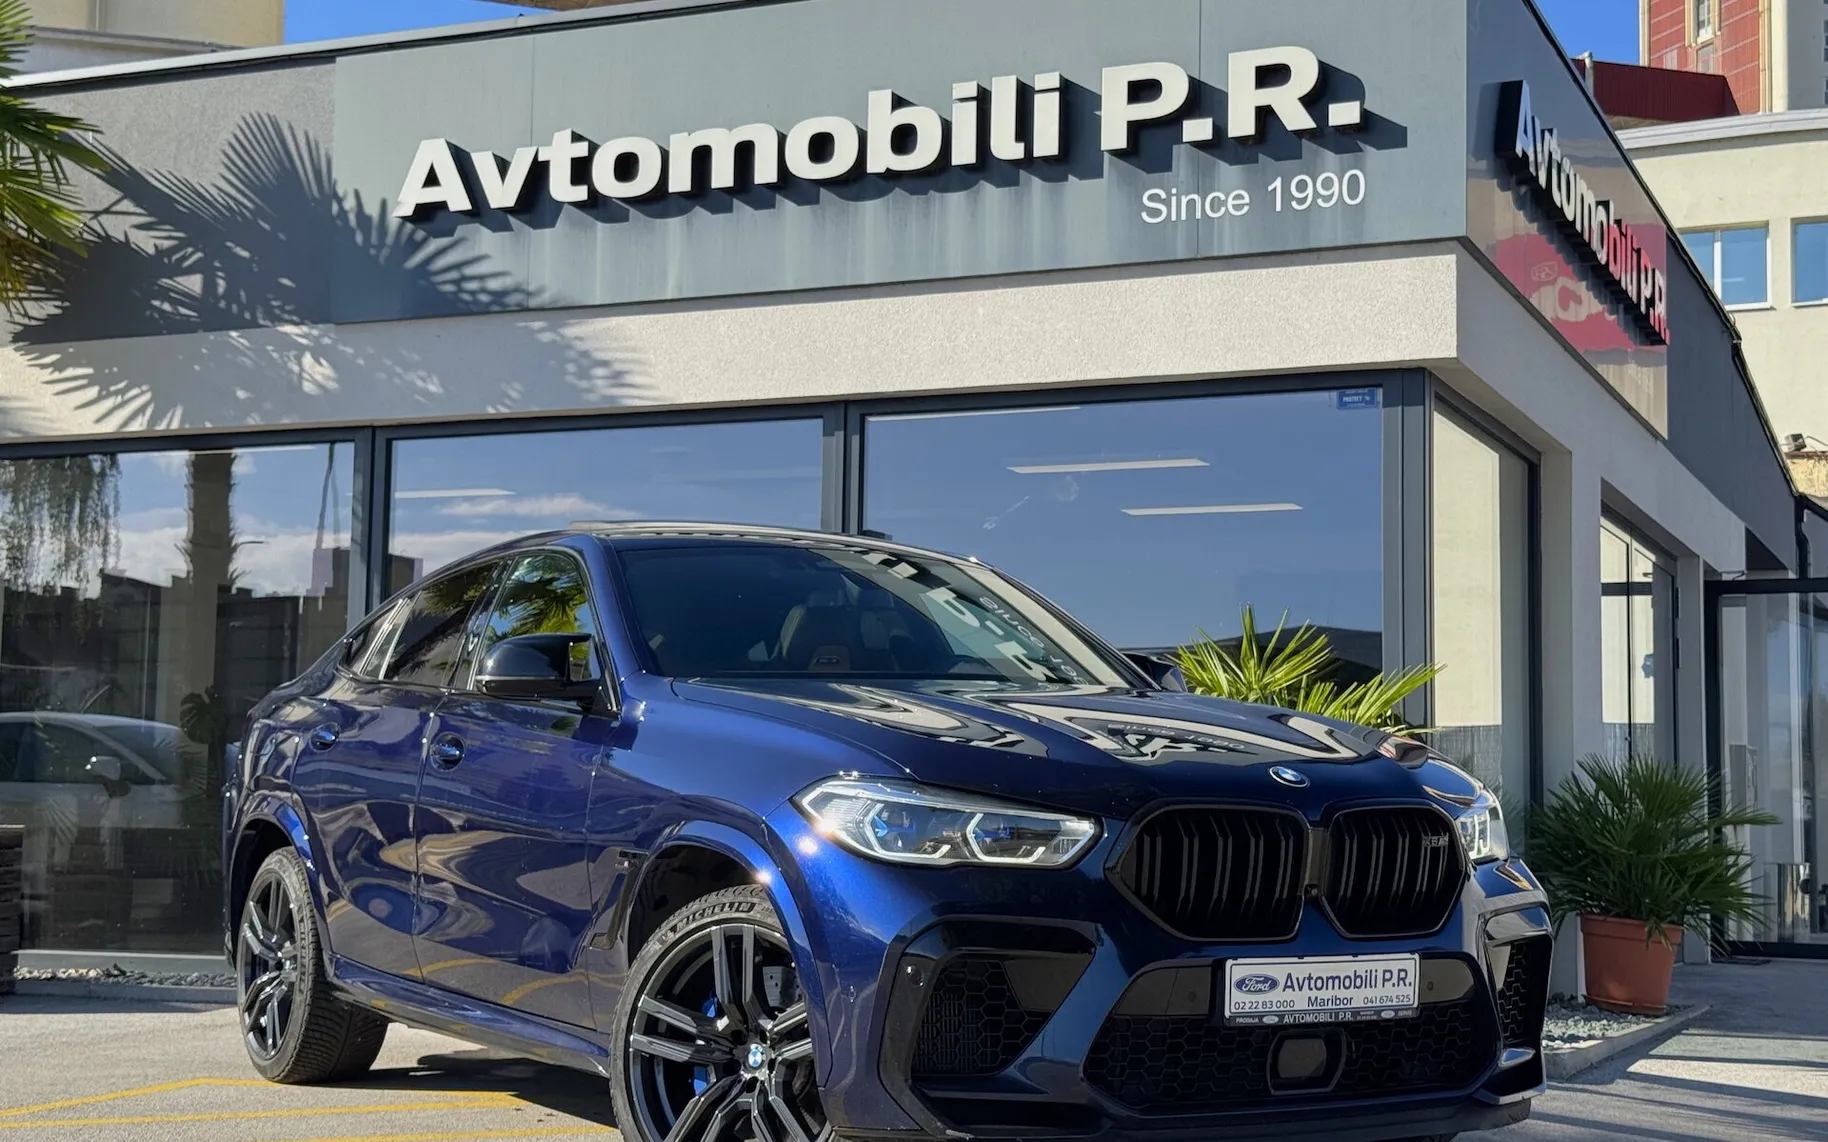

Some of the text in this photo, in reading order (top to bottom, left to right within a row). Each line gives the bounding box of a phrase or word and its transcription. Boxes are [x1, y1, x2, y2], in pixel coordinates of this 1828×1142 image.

[393, 45, 1362, 218] Avtomobili P.R.
[1141, 169, 1366, 224] Since 1990
[1515, 80, 1638, 304] Avtomobili
[676, 902, 752, 931] MICHELIN
[1242, 977, 1272, 991] Ford
[1282, 968, 1412, 992] Avtomobili P.R.
[1307, 995, 1354, 1008] Maribor
[1283, 1012, 1335, 1024] AVTOMOBILI
[1339, 1011, 1354, 1021] P.R.
